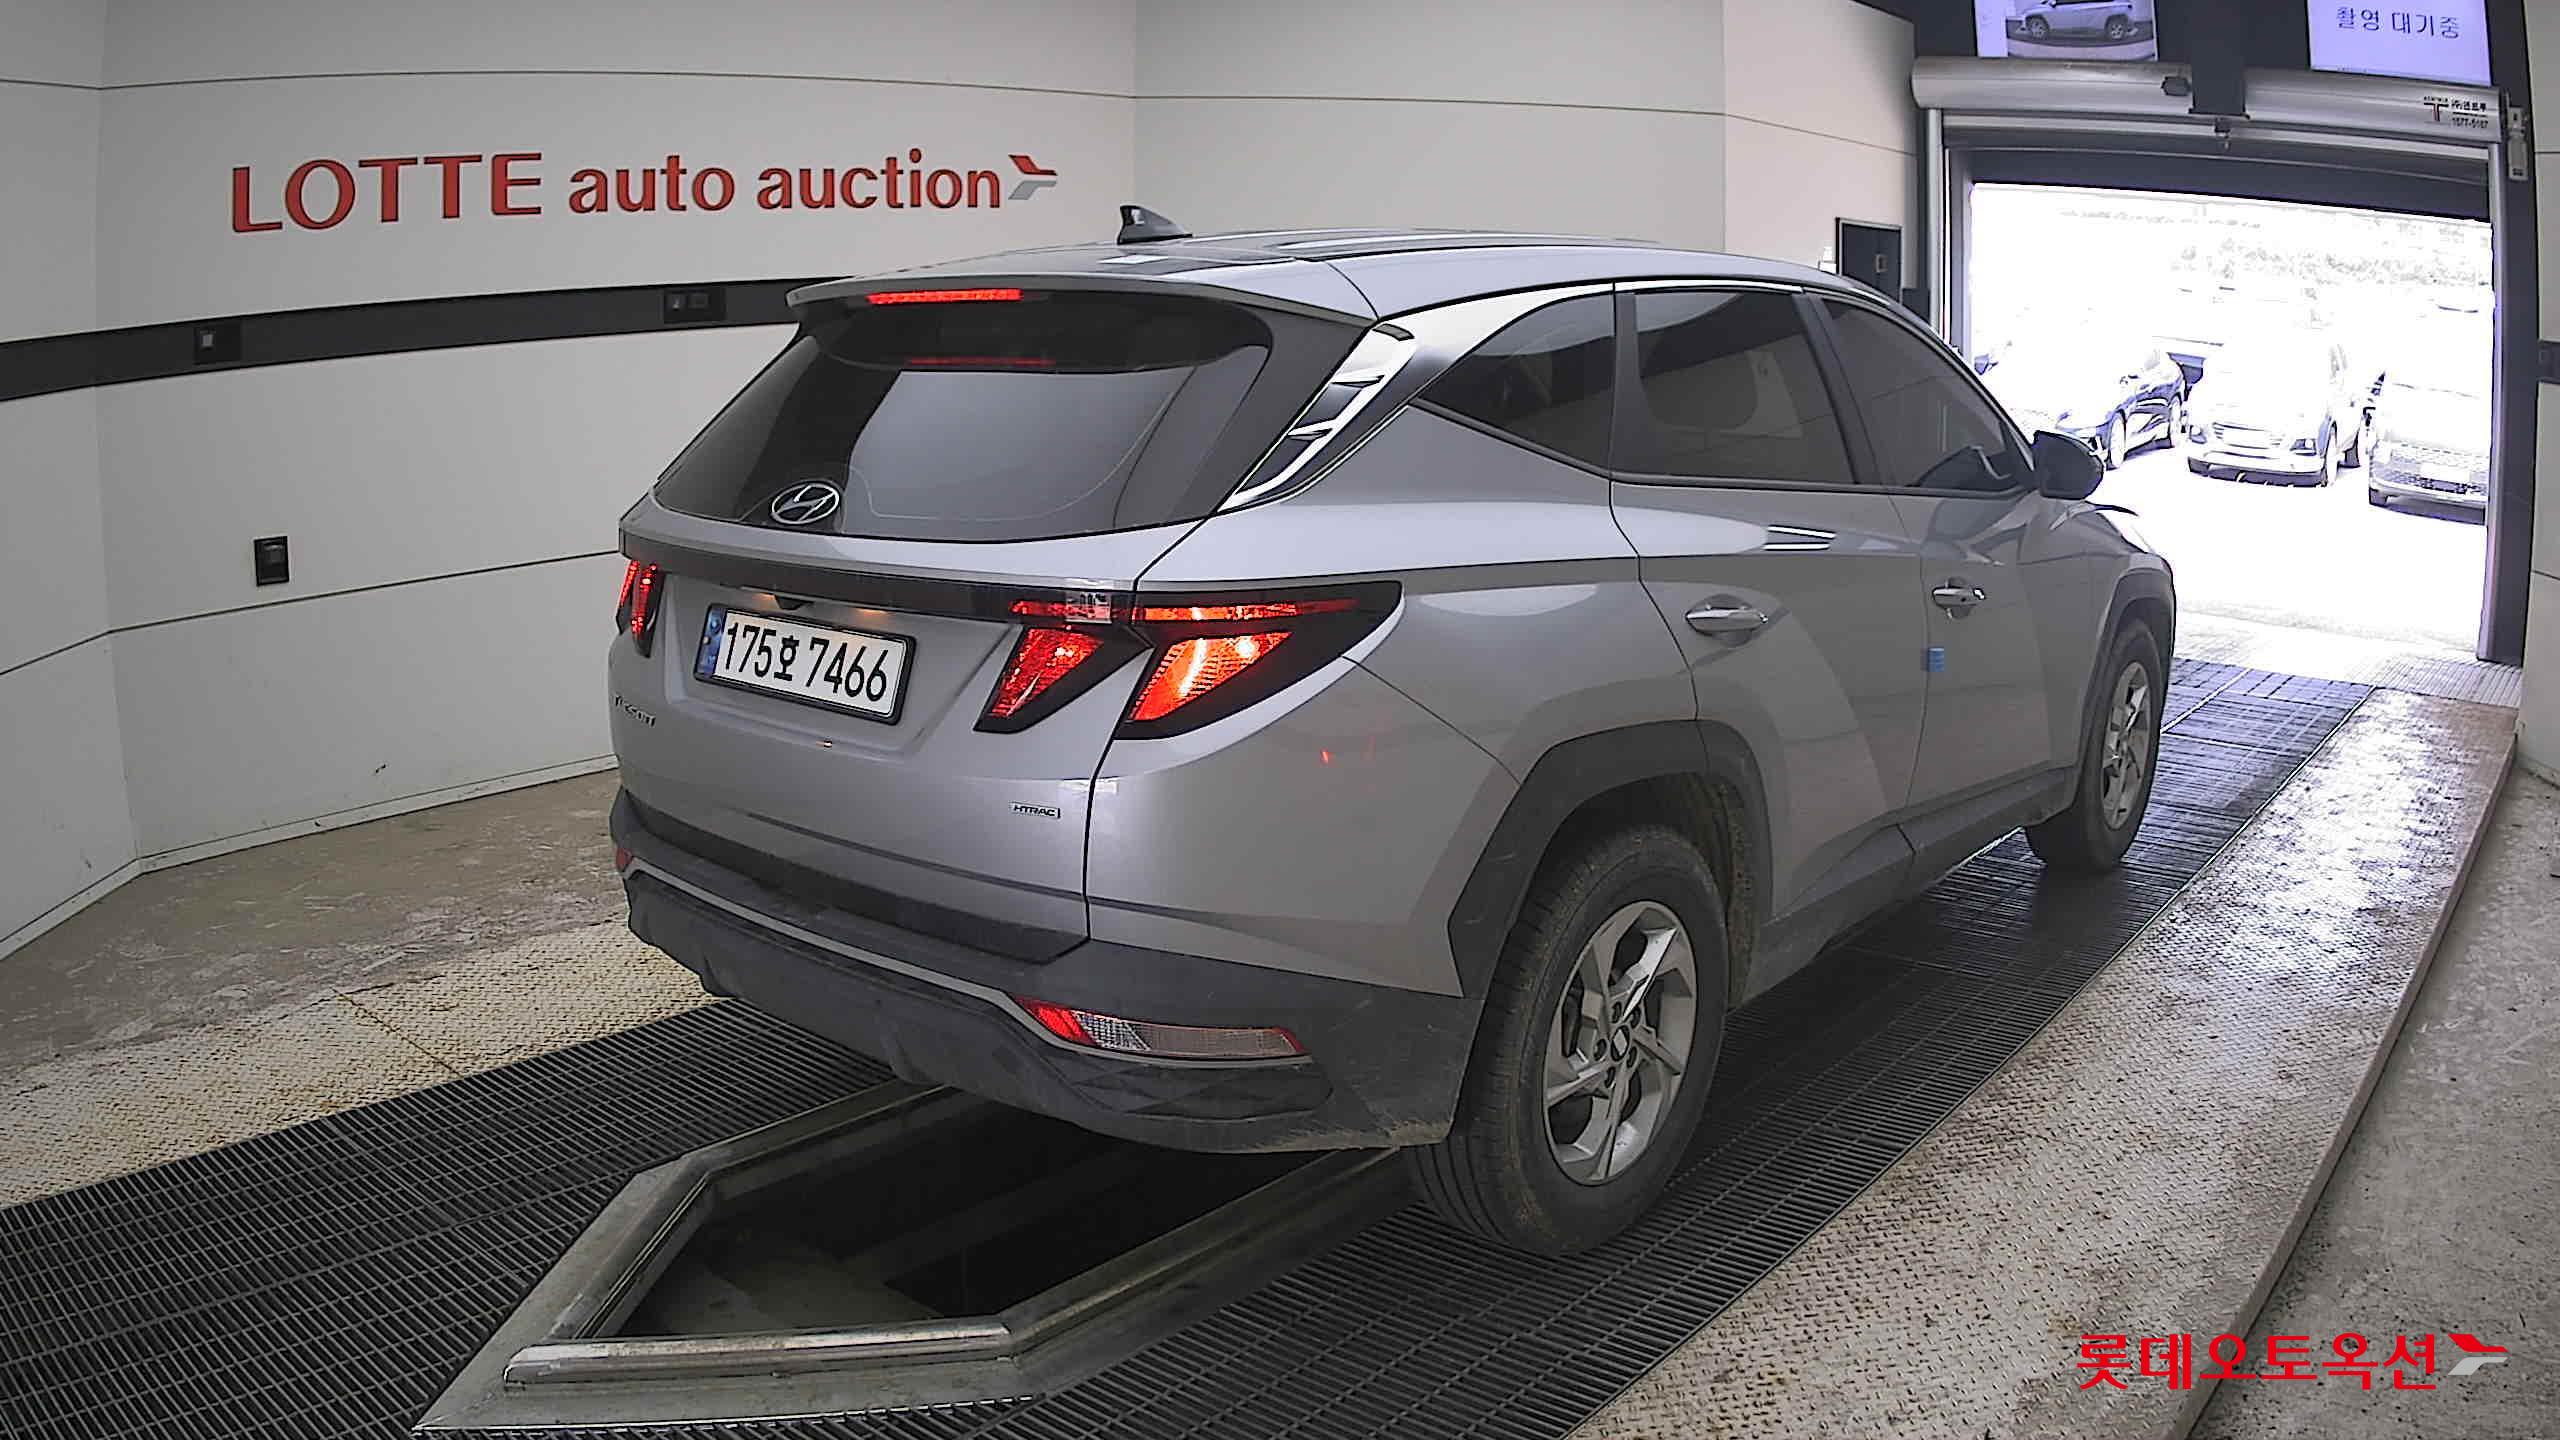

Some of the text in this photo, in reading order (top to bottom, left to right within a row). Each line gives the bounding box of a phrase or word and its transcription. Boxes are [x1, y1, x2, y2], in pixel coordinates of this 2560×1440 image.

[2338, 7, 2459, 39] 촬영 대기중
[233, 148, 1001, 233] LOTTE auto auction
[725, 622, 889, 702] 175호 7466
[1013, 804, 1056, 817] HTRAC
